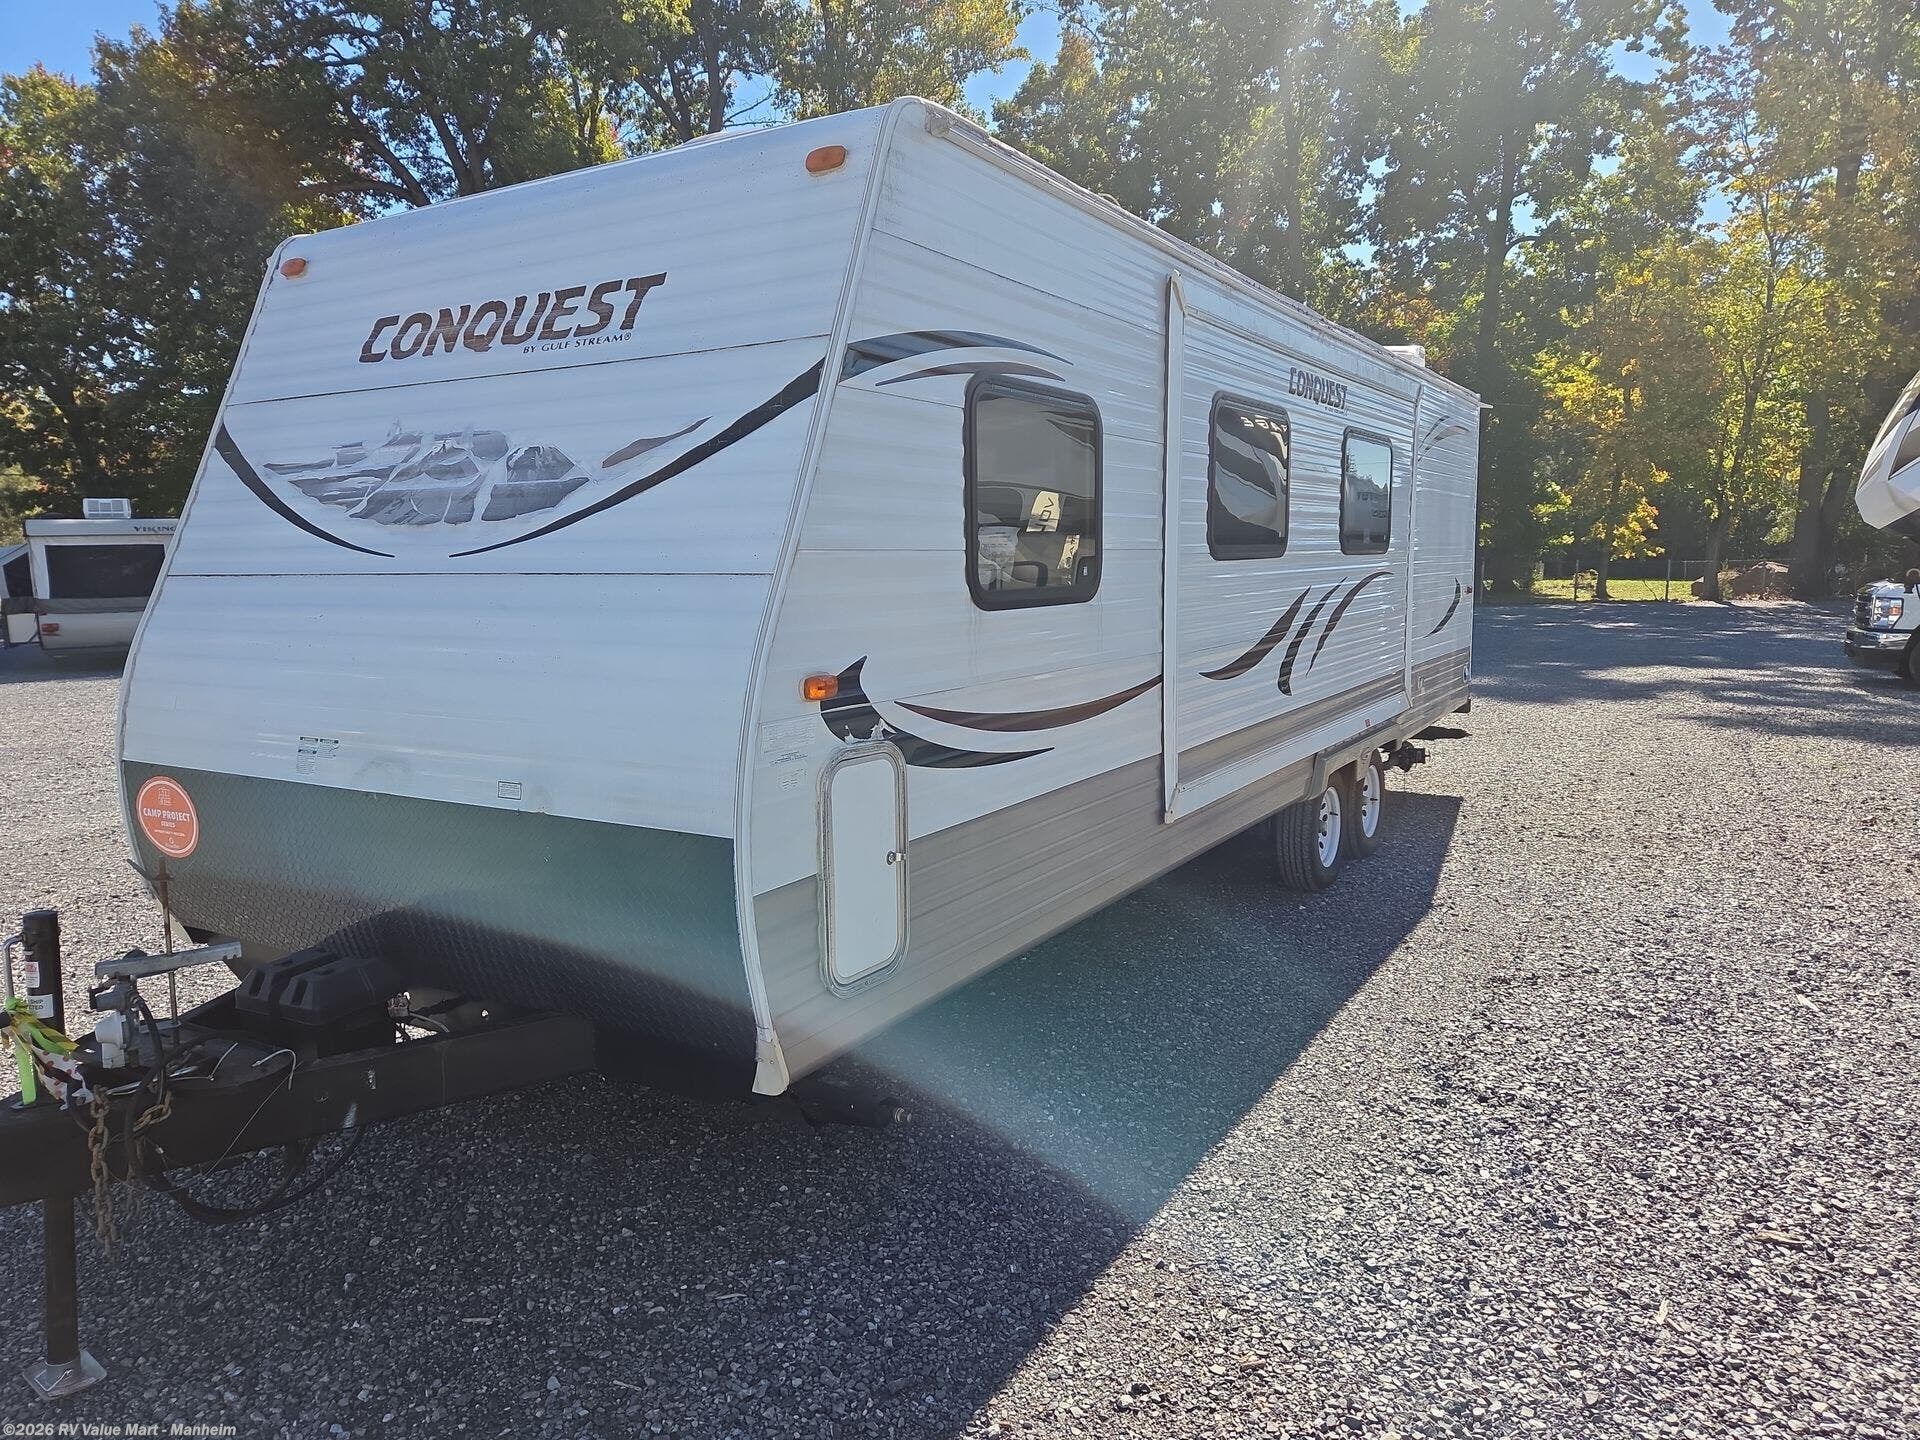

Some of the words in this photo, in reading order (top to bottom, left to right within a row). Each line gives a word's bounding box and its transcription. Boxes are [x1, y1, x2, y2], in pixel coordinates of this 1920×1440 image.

[359, 272, 667, 363] CONQUEST
[523, 345, 537, 354] BY
[541, 341, 571, 351] GULF
[1289, 366, 1348, 410] CONQUEST
[143, 807, 161, 818] CAMP
[162, 810, 190, 822] PROJECT
